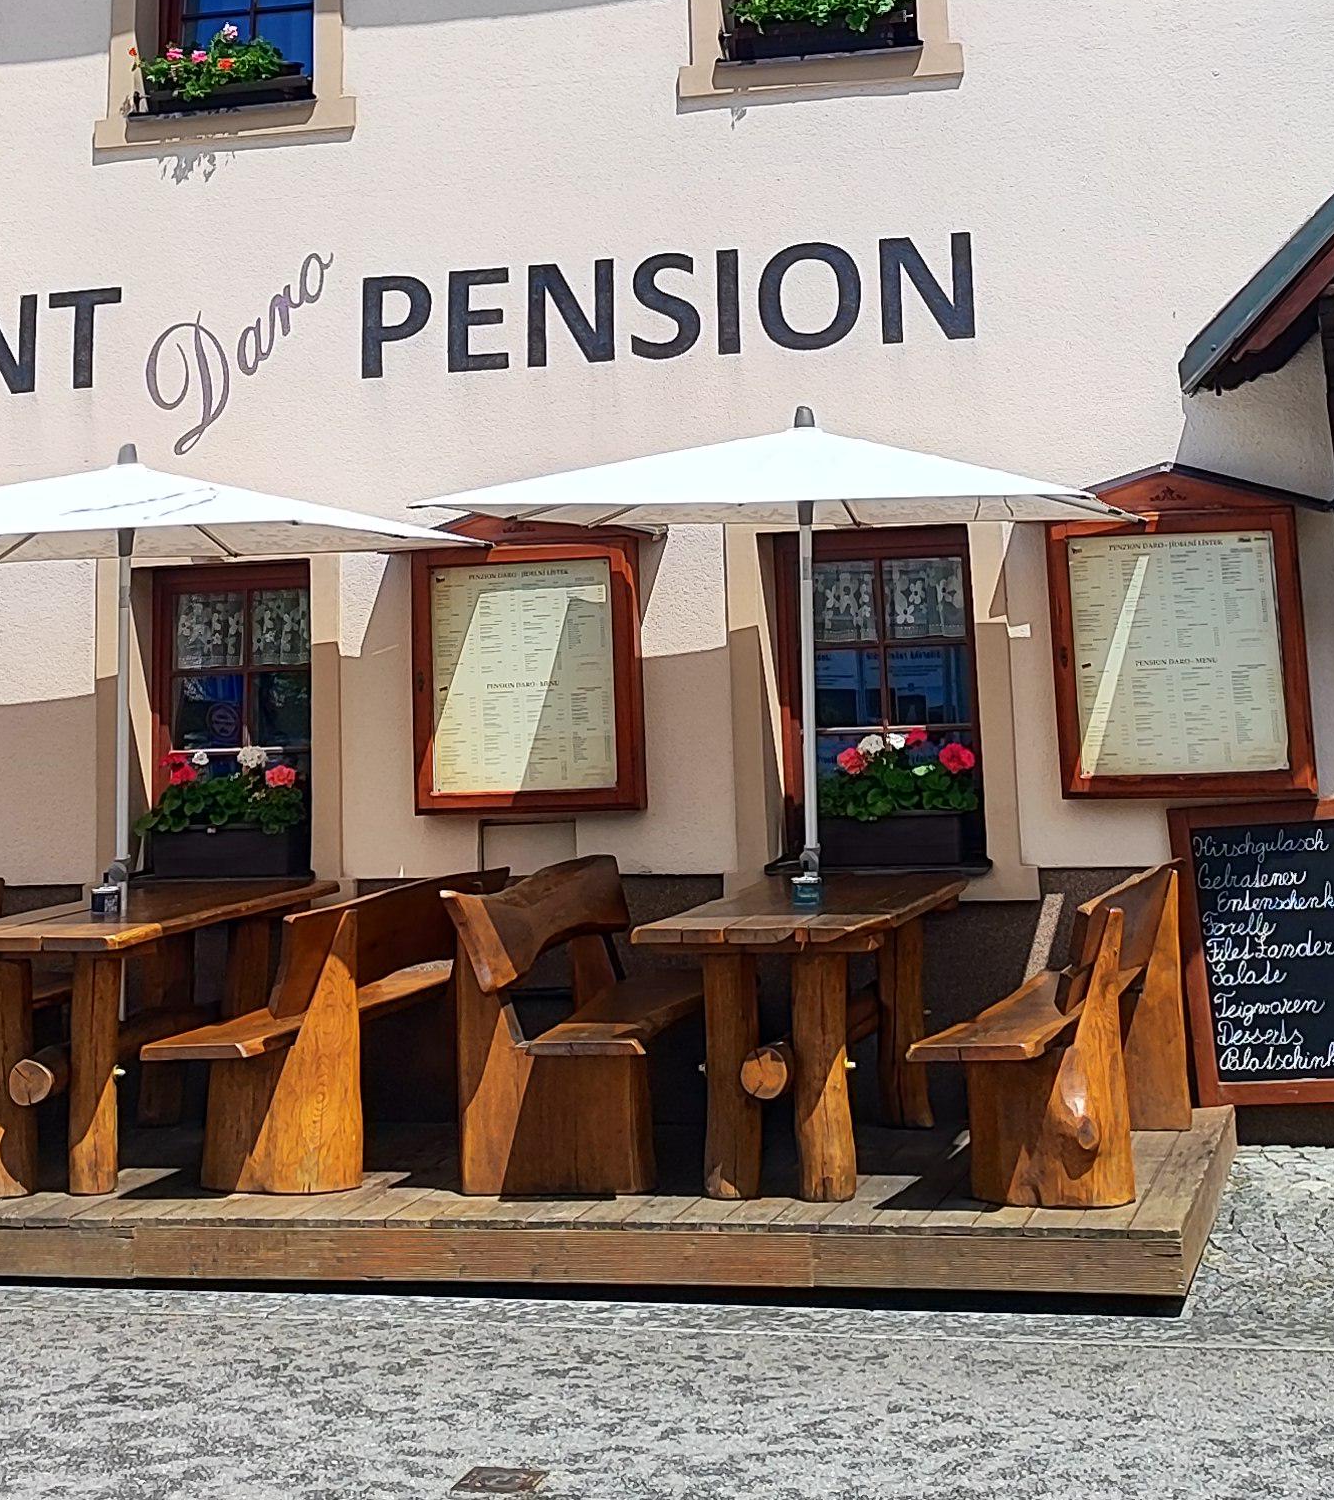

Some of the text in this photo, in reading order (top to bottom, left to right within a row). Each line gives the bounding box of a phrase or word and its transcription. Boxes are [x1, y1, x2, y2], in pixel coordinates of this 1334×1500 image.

[144, 250, 334, 456] Daro
[360, 231, 977, 380] PENSION
[1192, 828, 1330, 863] Hirschgulasch
[1202, 911, 1277, 937] Forelle
[1206, 936, 1254, 963] Filet
[1212, 960, 1287, 986] Salate
[1214, 990, 1326, 1026] Teigwaren
[1217, 1018, 1304, 1046] Desserts
